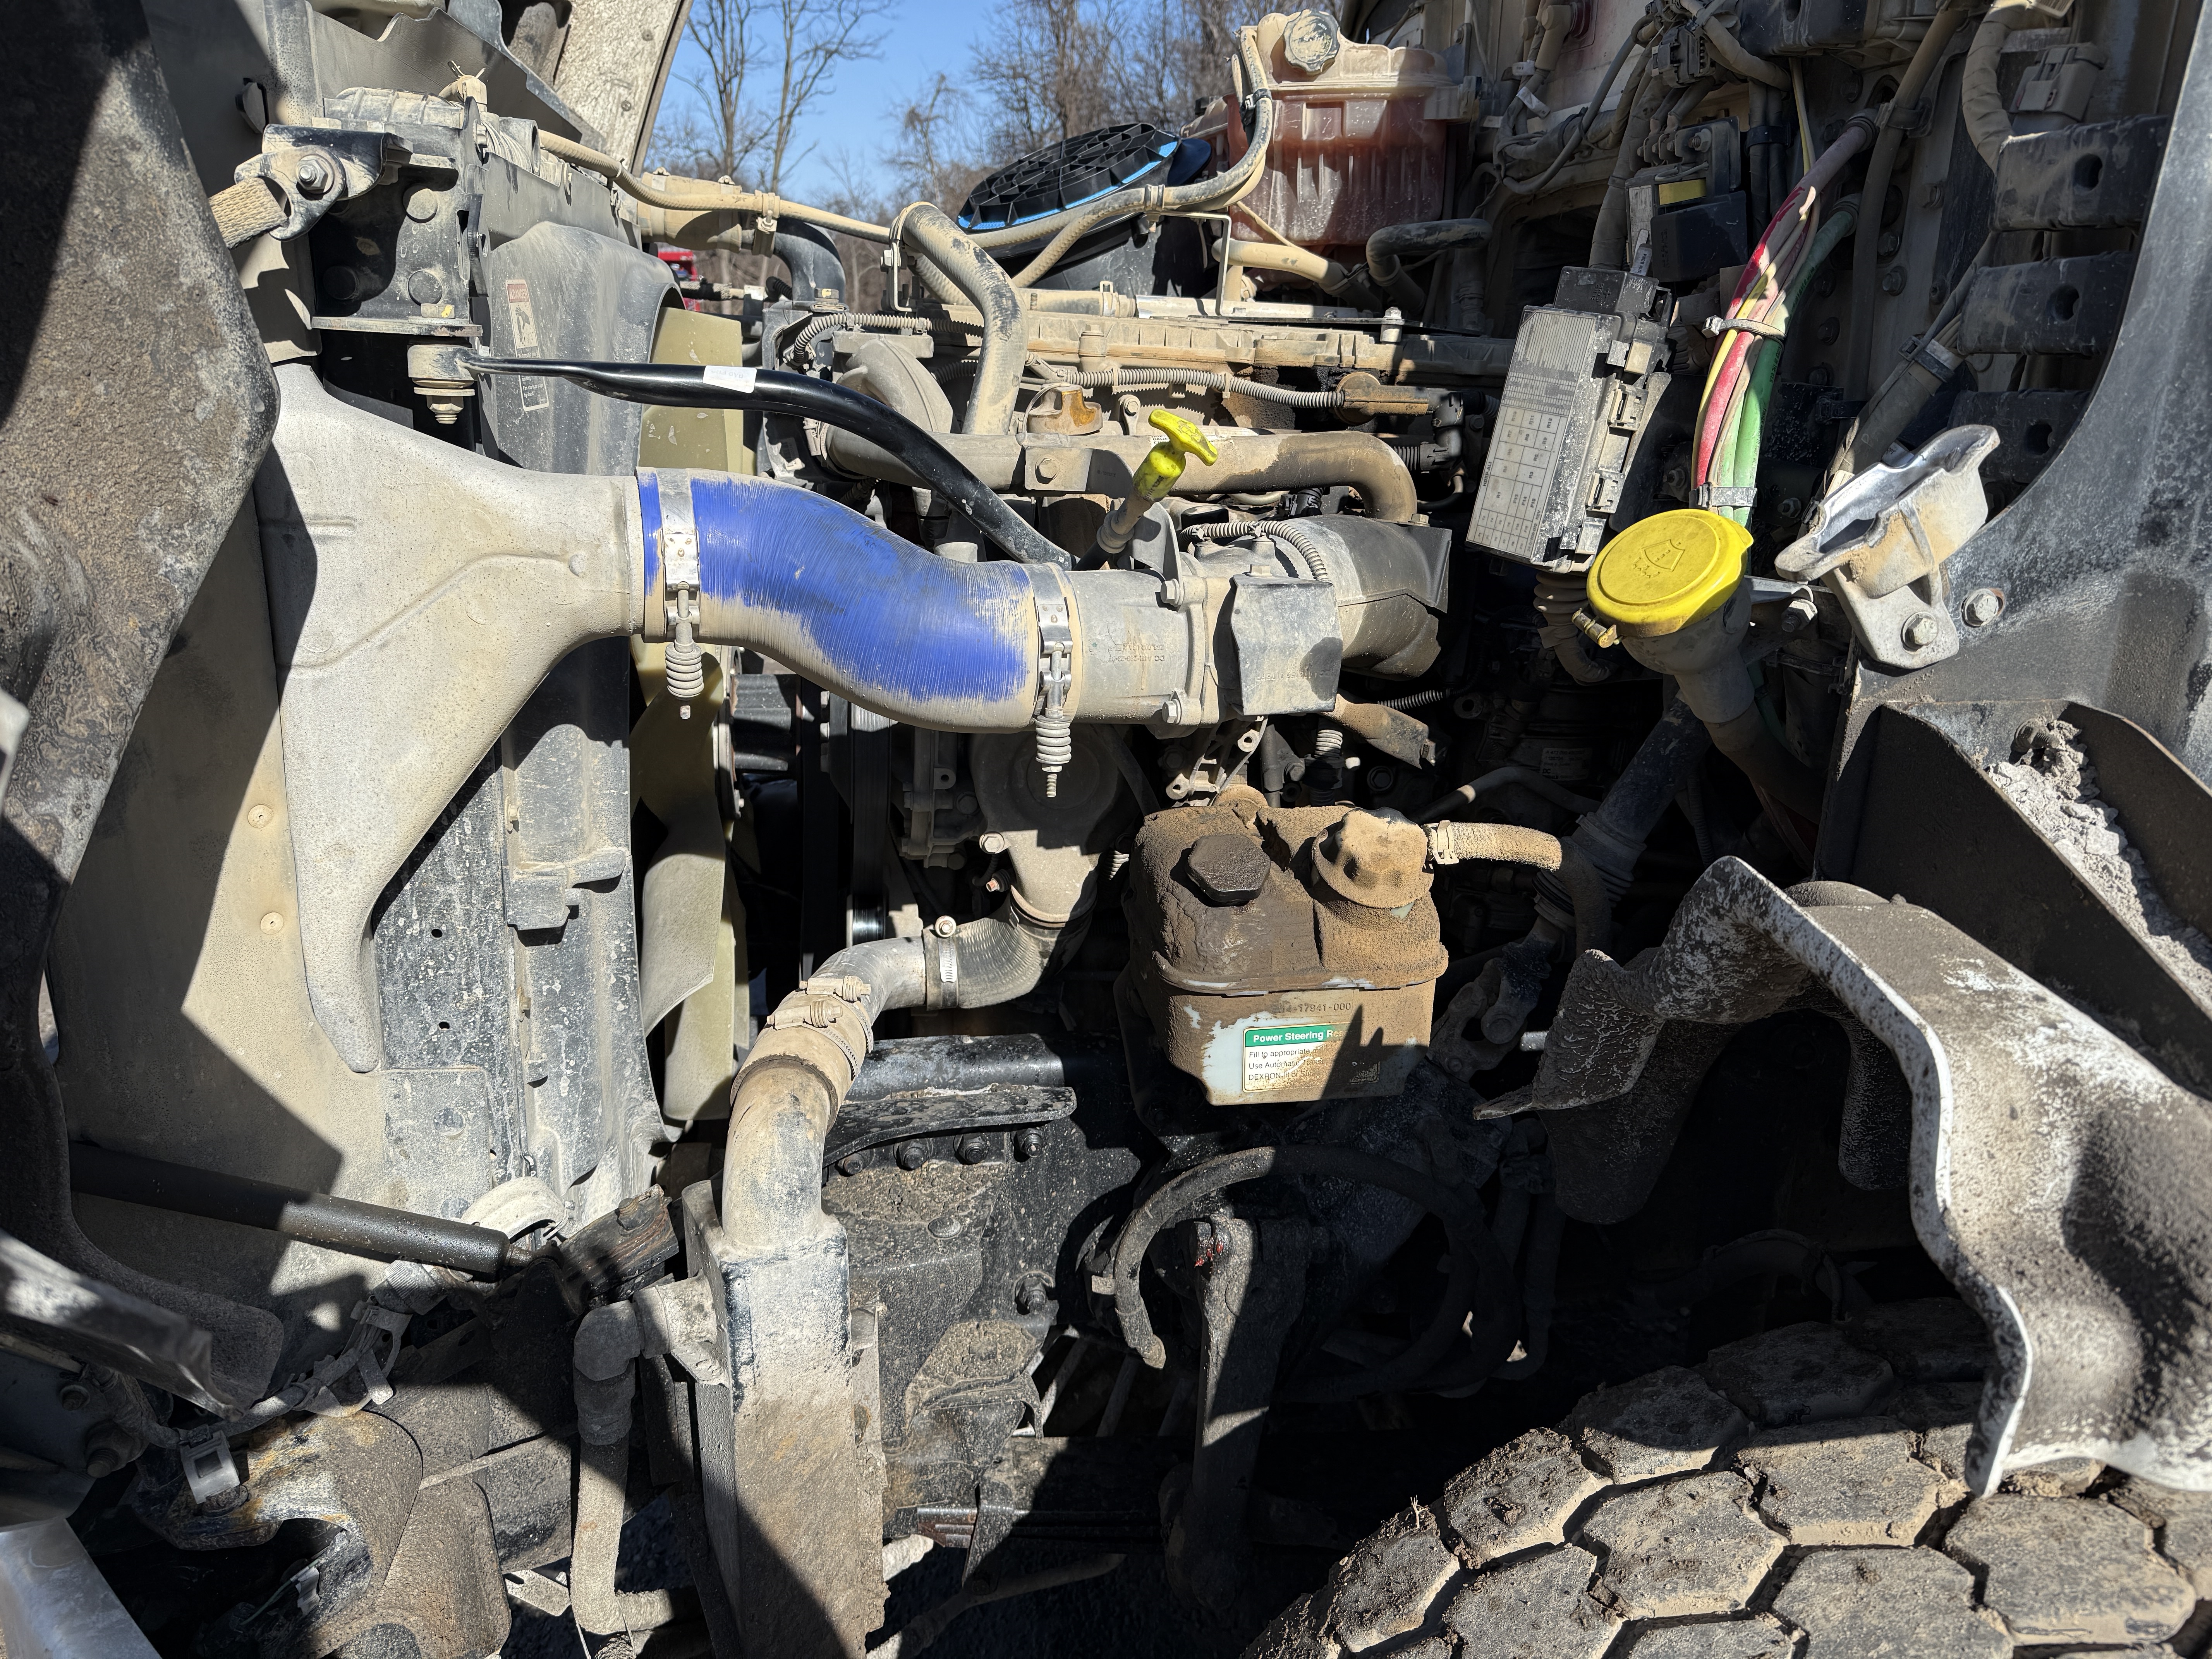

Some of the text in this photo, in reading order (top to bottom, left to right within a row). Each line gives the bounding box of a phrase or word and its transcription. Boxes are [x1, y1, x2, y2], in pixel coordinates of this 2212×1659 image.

[1253, 1034, 1283, 1043] Power
[1285, 1030, 1324, 1041] Steering
[1271, 1049, 1310, 1058] appropriate
[1264, 1060, 1300, 1068] Automatic
